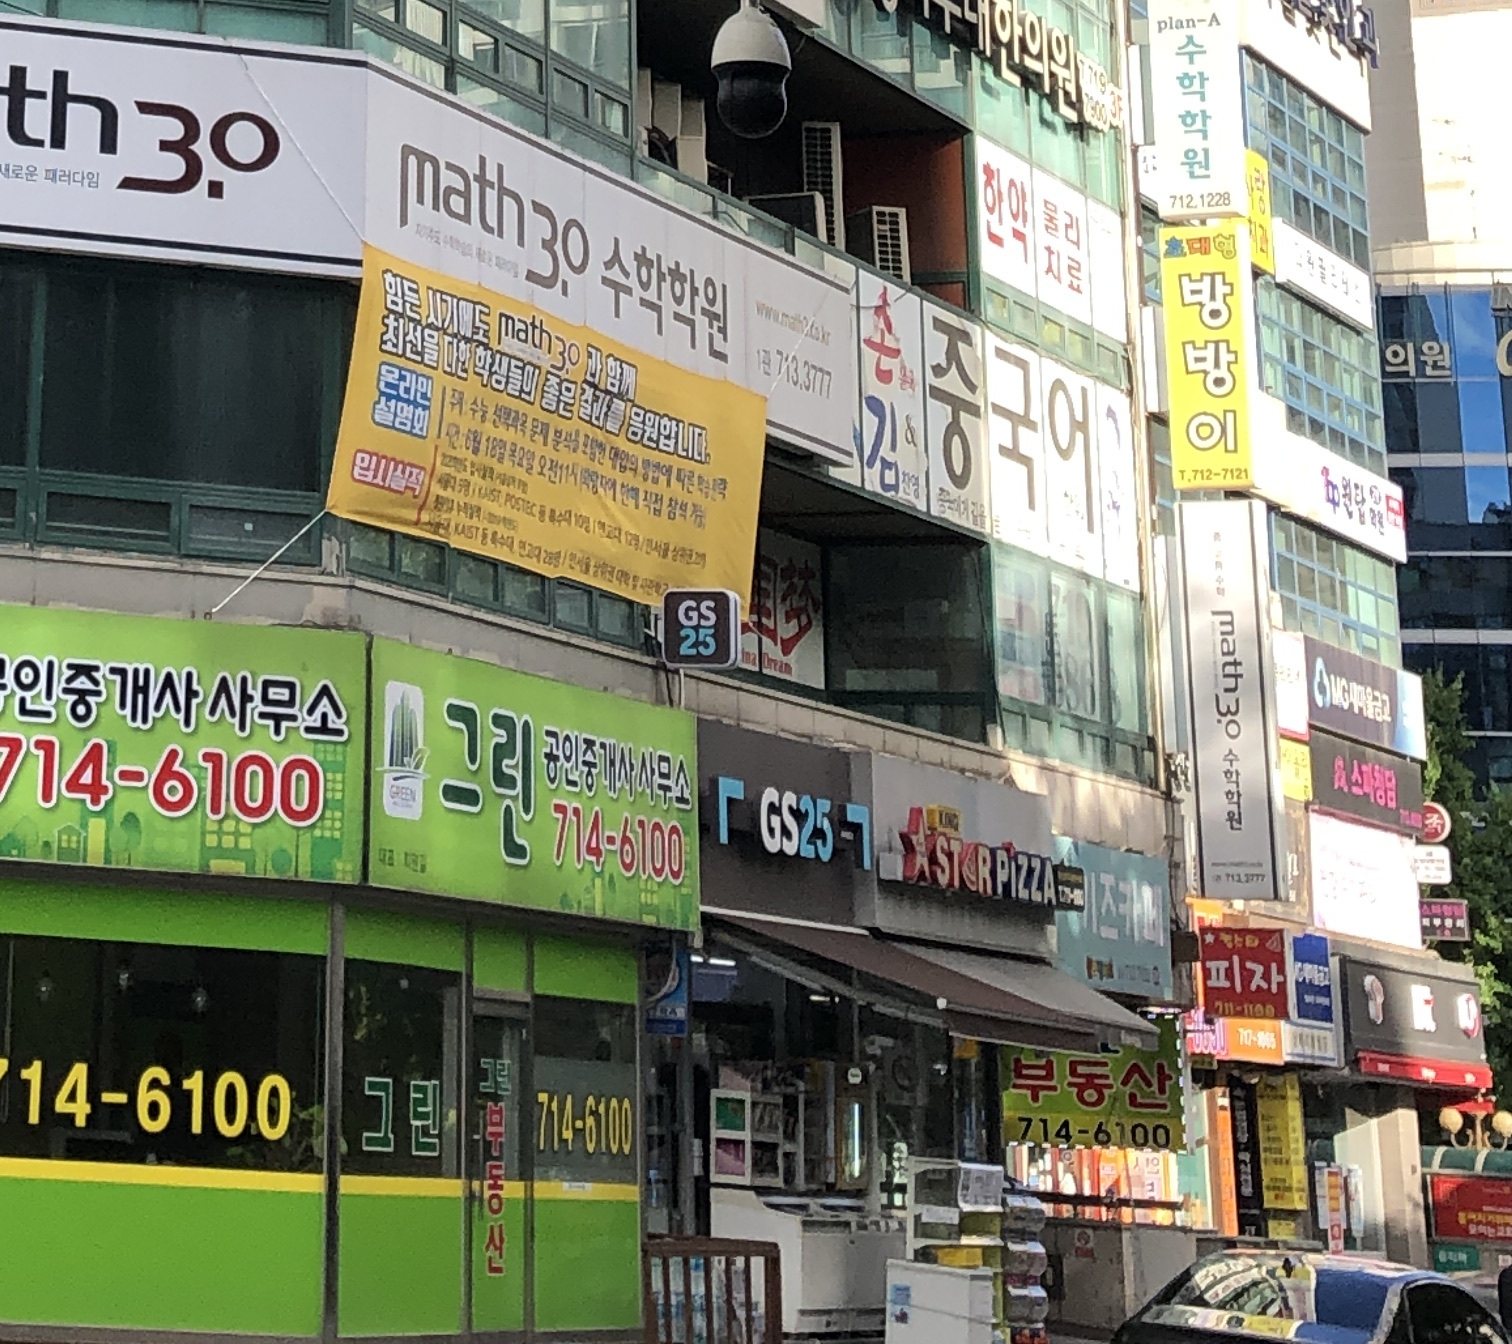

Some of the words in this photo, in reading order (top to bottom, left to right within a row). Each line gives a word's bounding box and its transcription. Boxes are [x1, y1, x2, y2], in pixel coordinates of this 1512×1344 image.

[1157, 12, 1222, 33] plan-A
[1174, 34, 1212, 180] 수학학원
[44, 167, 101, 189] 패러다임
[1169, 191, 1231, 209] 712.1228
[601, 236, 730, 365] 수학학원
[775, 347, 834, 400] 713.3777
[1178, 270, 1238, 454] 방방이
[1384, 340, 1452, 377] 의원
[863, 393, 901, 496] 김
[903, 413, 918, 448] &
[928, 313, 1095, 536] 중국어
[677, 600, 718, 627] GS
[679, 629, 717, 657] 25
[209, 671, 350, 742] 사무소
[439, 696, 535, 866] 그린
[542, 725, 636, 802] 공인중개사
[637, 746, 693, 812] 사무소
[1221, 746, 1244, 832] 수학학원
[551, 800, 686, 887] 714-6100
[759, 786, 833, 863] GS25
[996, 848, 1057, 907] PIZZA
[1205, 954, 1285, 994] 피자
[362, 1076, 441, 1157] 그린
[1010, 1056, 1173, 1111] 부동산
[537, 1091, 633, 1155] 714-6100
[1016, 1116, 1171, 1148] 714-6100
[484, 1101, 507, 1277] 부동산
